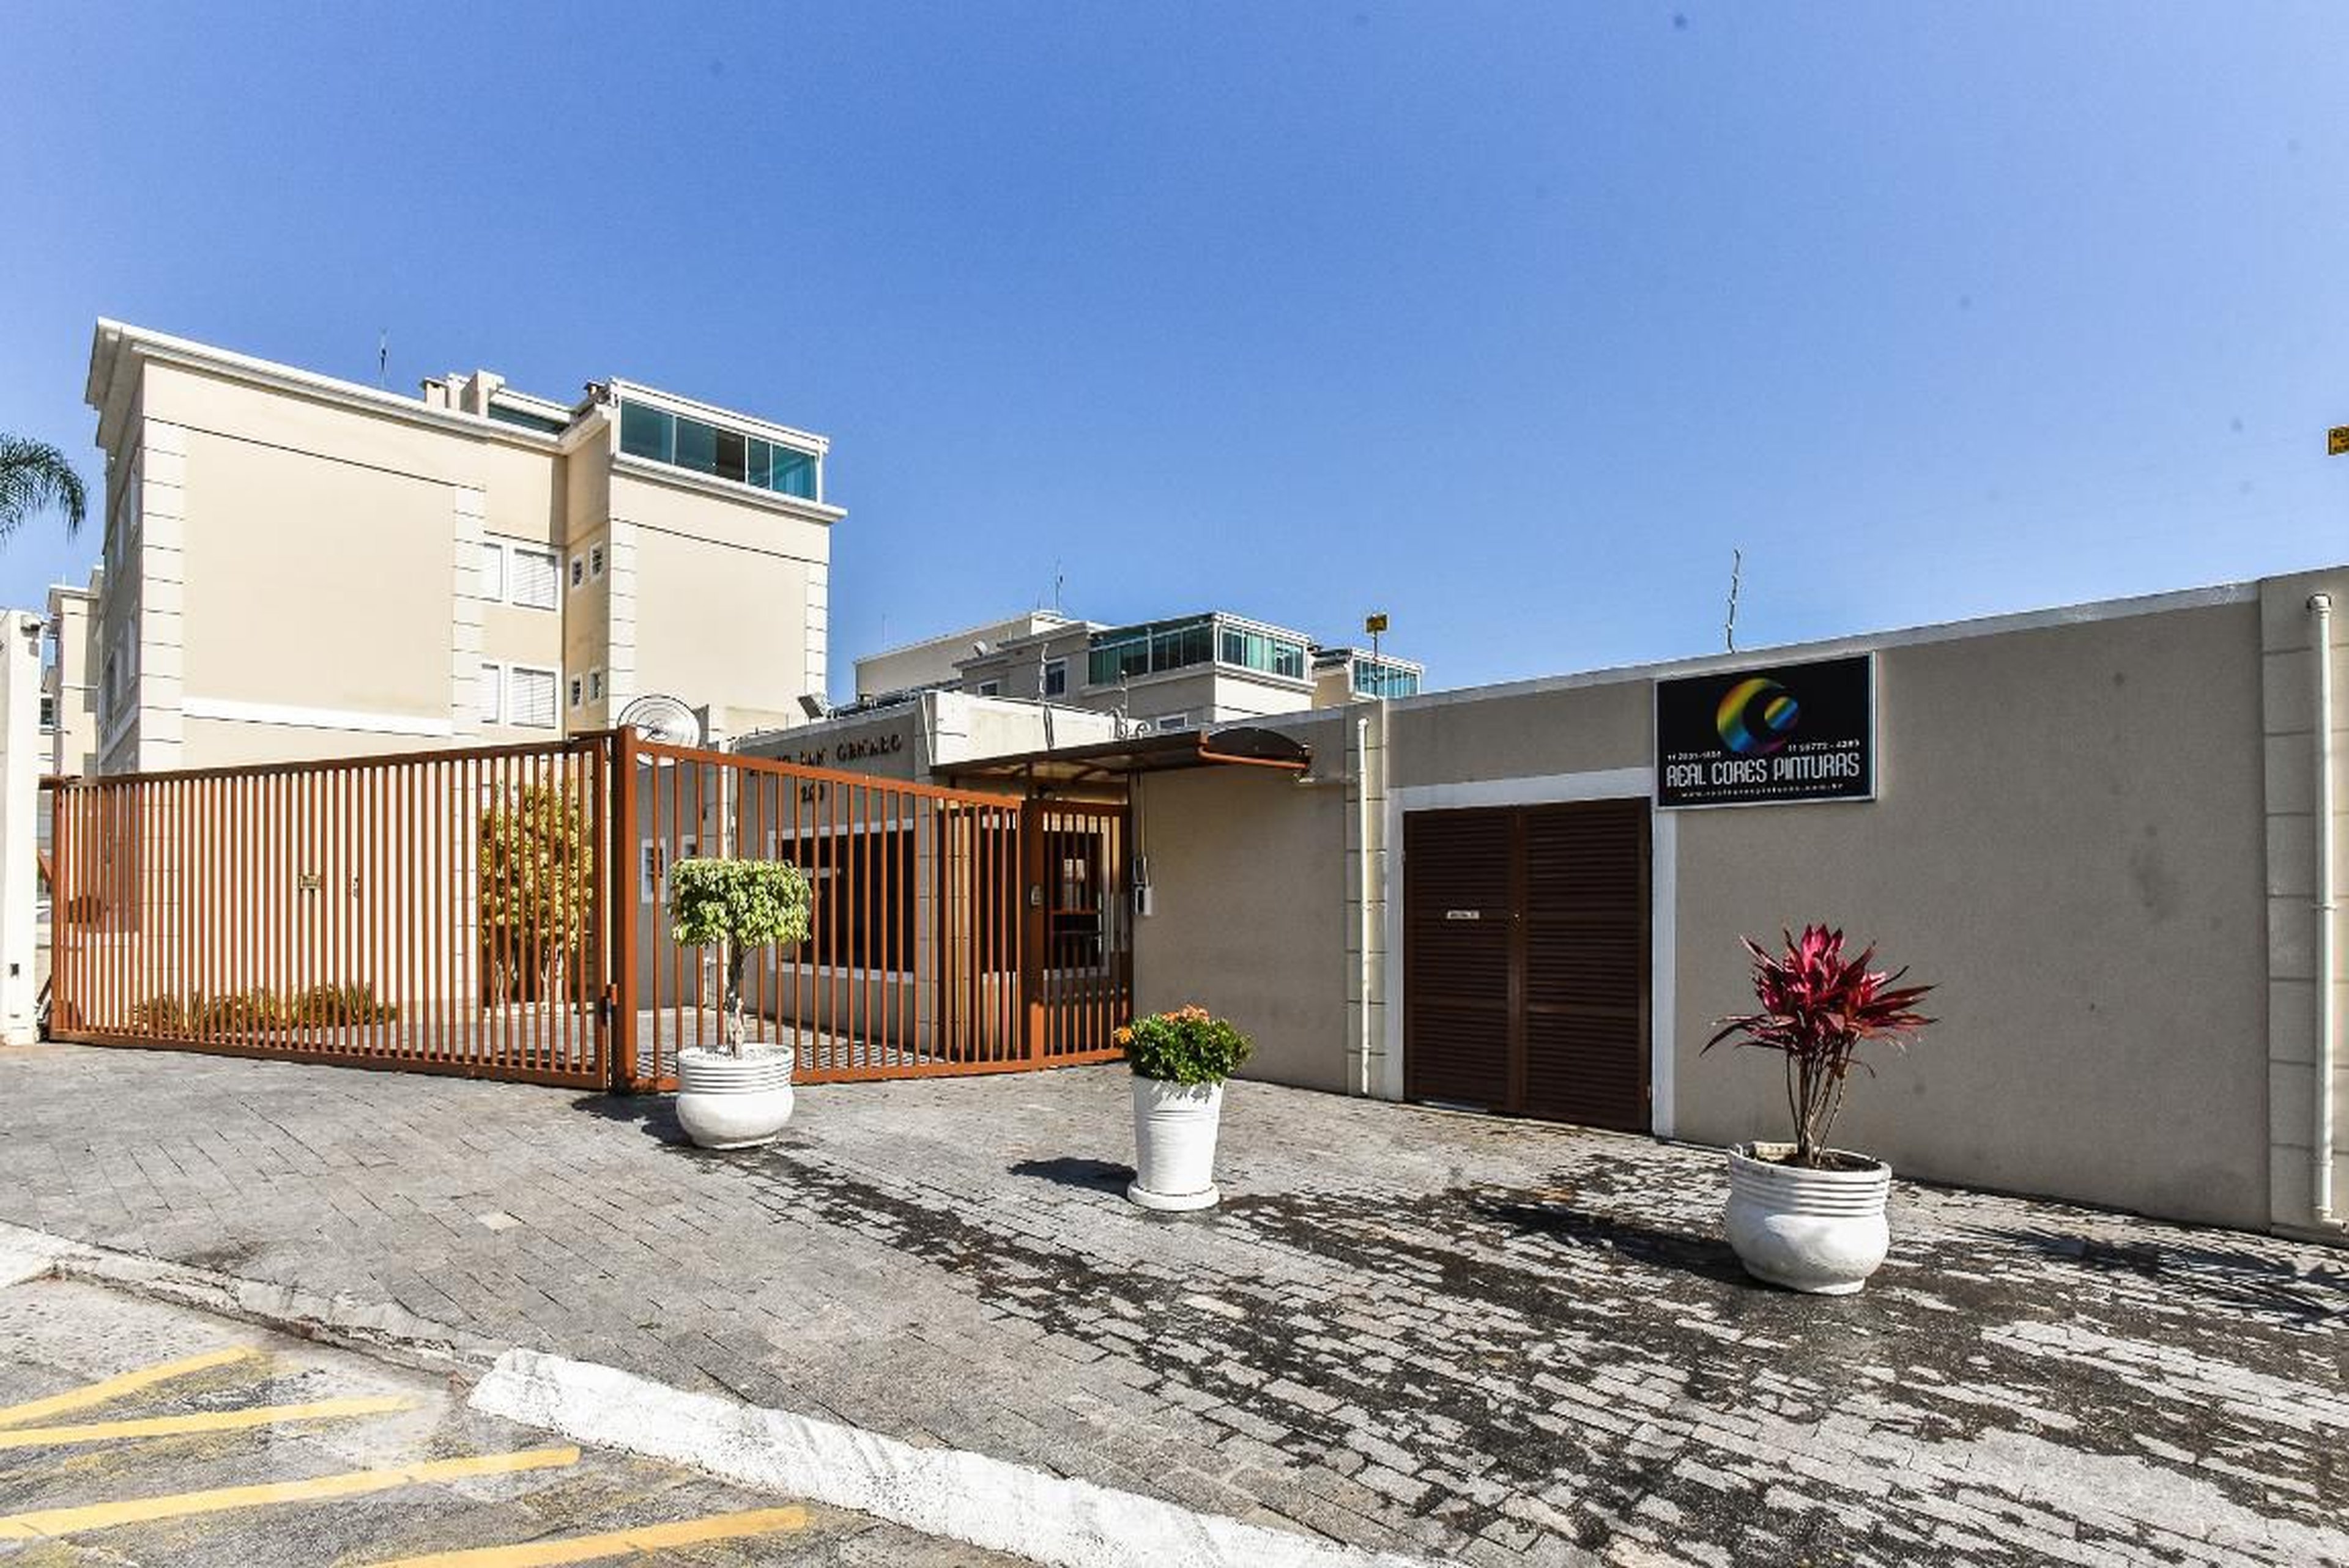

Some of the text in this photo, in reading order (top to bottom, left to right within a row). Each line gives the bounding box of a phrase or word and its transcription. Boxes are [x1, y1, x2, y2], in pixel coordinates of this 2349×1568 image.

[1666, 752, 1860, 787] REAL CORES PINTURAS
